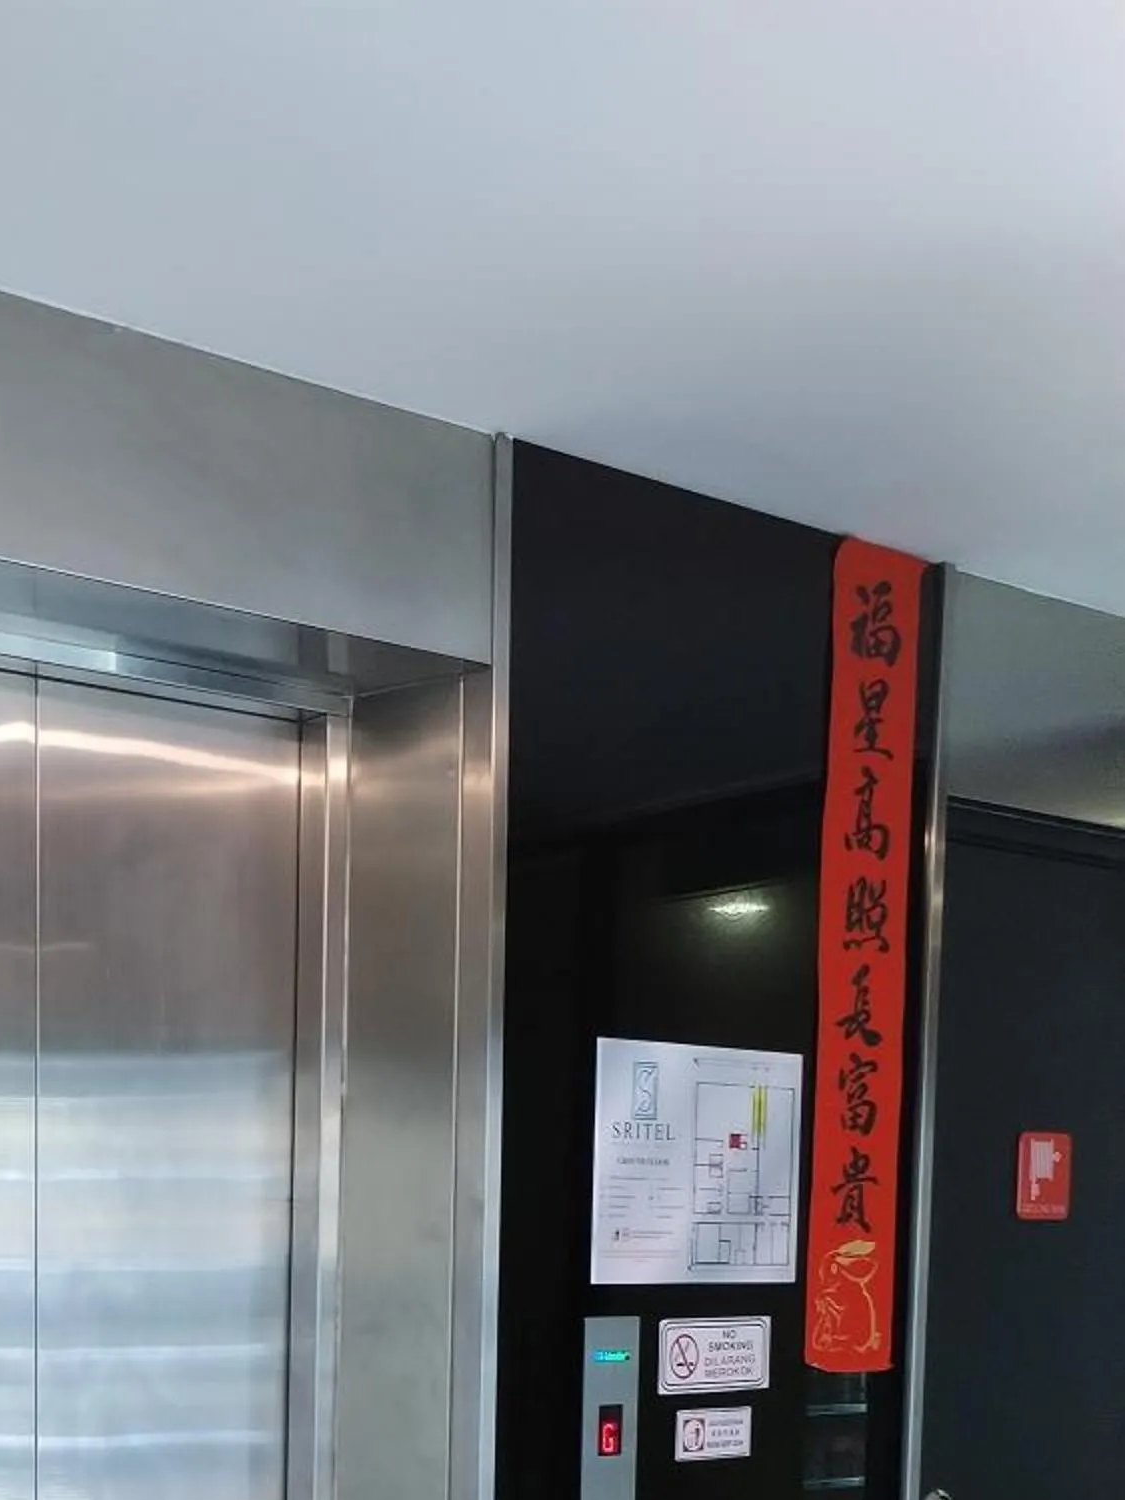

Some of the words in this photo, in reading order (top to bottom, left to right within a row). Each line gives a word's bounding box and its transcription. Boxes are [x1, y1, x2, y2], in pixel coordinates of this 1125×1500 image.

[830, 580, 902, 1235] 福星高照長富貴
[611, 1122, 676, 1141] SRITEL
[722, 1329, 737, 1339] NO
[707, 1340, 754, 1353] SMOKING
[704, 1353, 756, 1367] DILARANG
